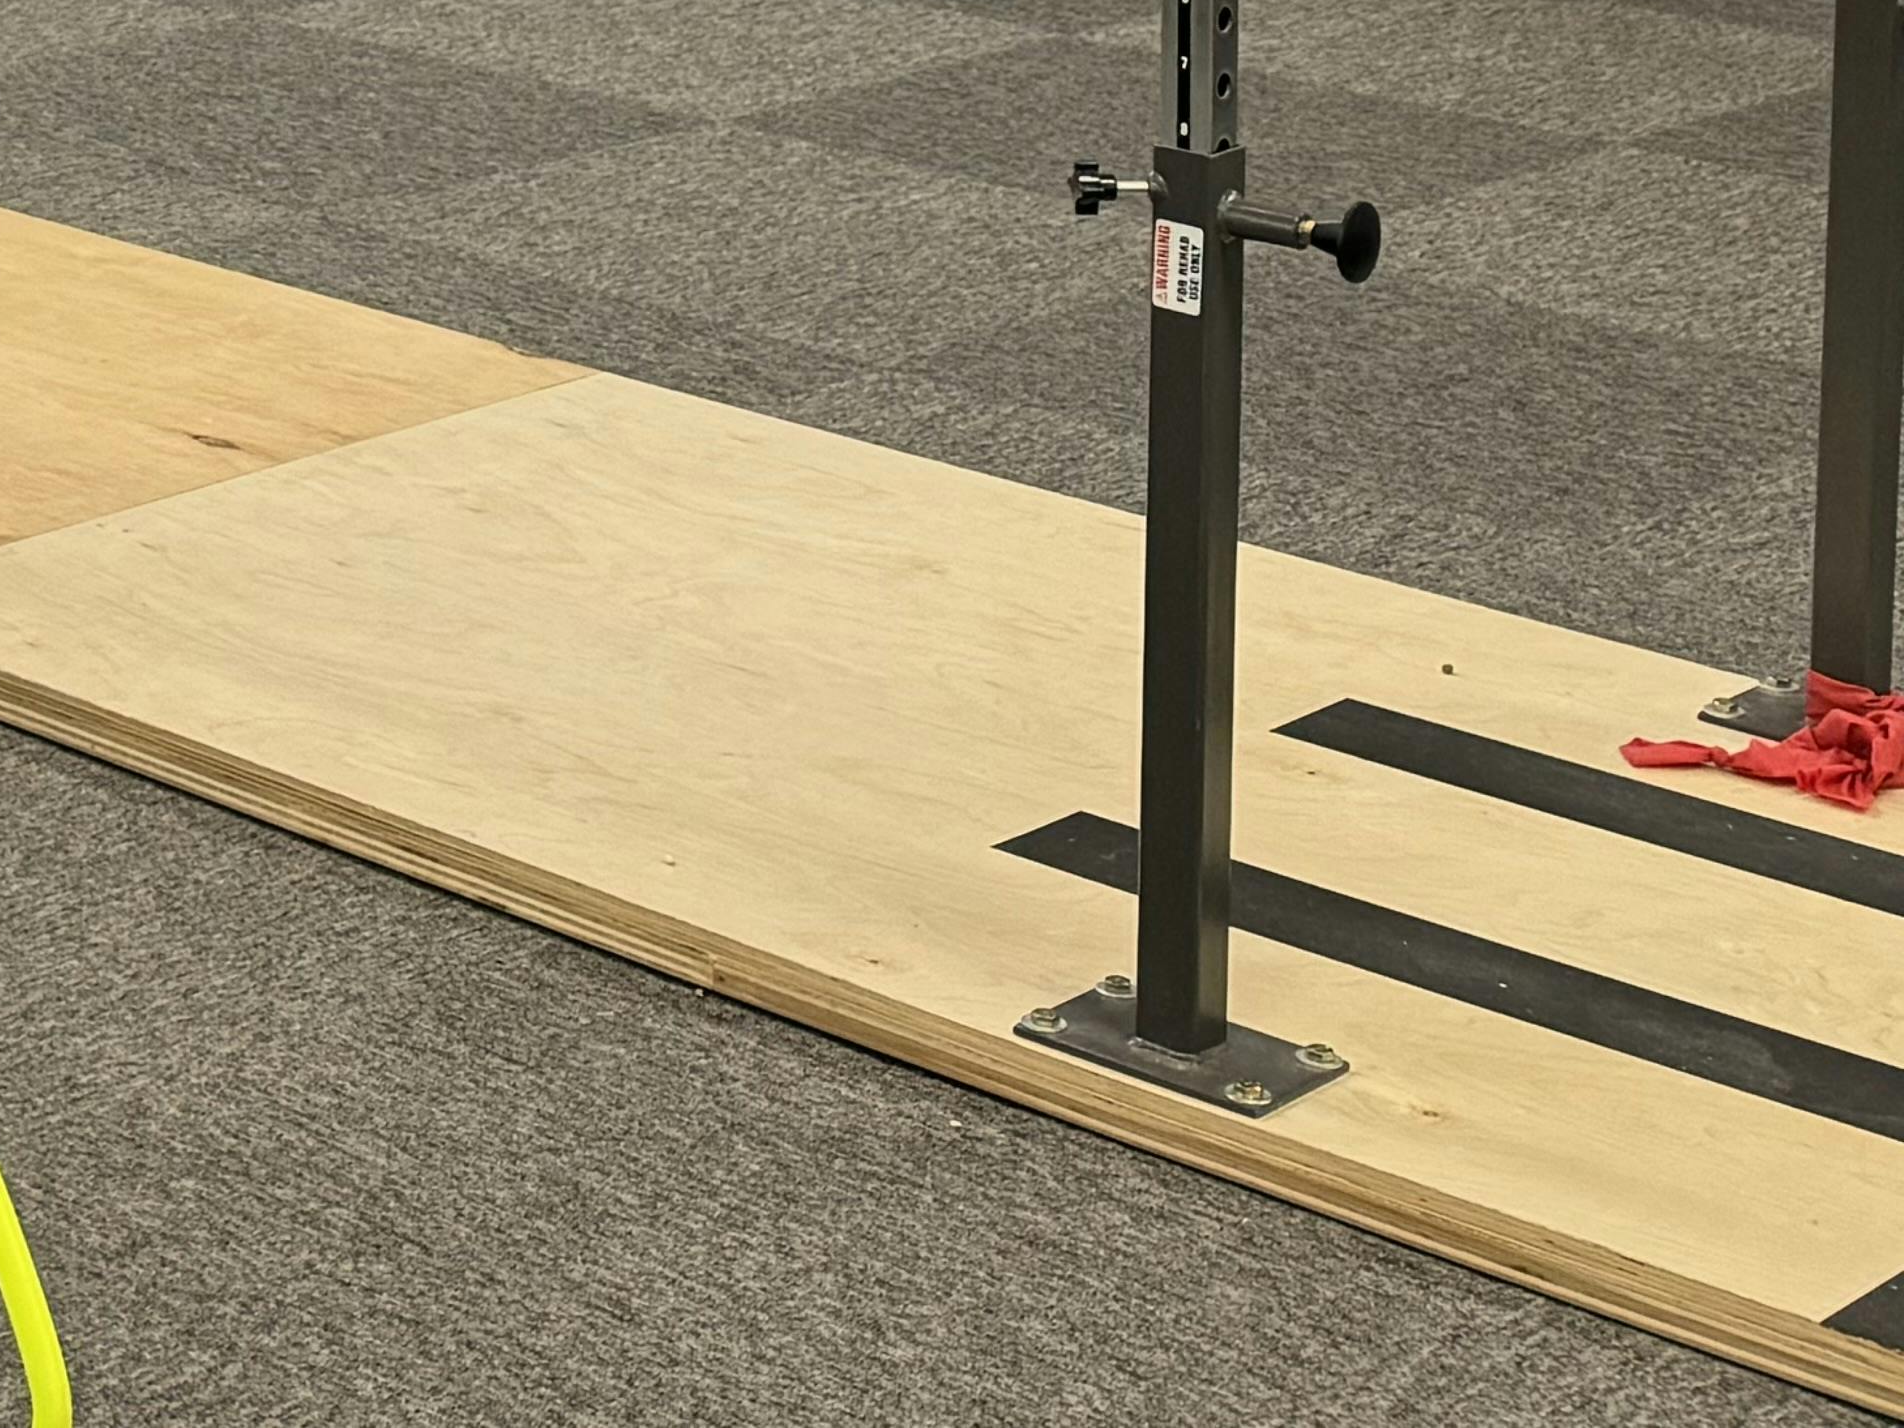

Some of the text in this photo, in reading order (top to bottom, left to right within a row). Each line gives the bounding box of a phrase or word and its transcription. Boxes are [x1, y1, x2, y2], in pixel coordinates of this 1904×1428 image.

[1156, 226, 1170, 289] WARNING
[1189, 245, 1201, 300] USE ONLY
[1177, 280, 1188, 303] FOR
